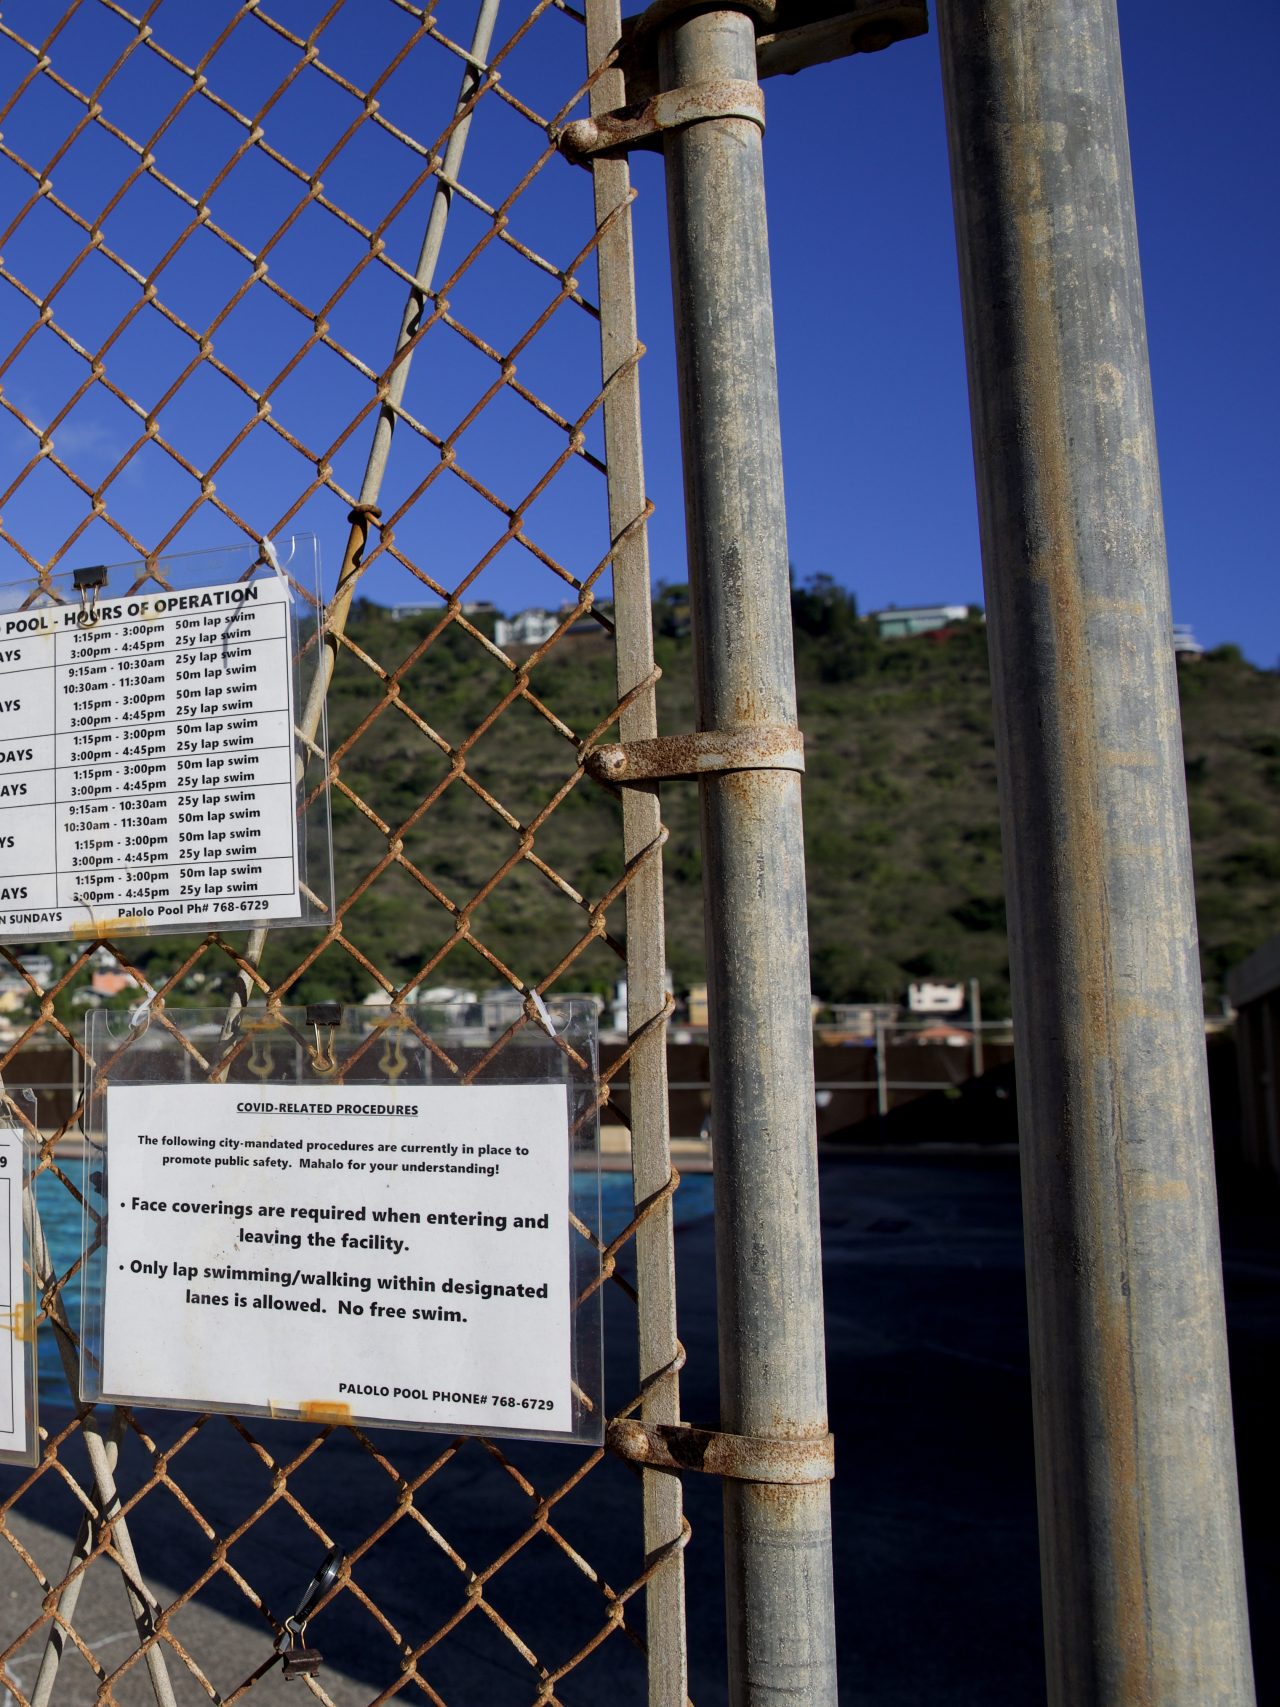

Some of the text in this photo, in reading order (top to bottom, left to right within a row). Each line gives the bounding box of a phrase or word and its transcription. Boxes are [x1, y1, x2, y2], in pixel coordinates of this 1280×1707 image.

[6, 617, 49, 635] POOL
[64, 605, 123, 624] HOURS
[127, 601, 149, 617] OF
[154, 587, 258, 613] OPERATION
[73, 629, 112, 643] 1:15pm
[123, 625, 165, 637] 3:00pm
[175, 619, 200, 630] 50m
[203, 616, 222, 628] lap
[225, 609, 256, 624] swim
[70, 647, 111, 659] 3:00pm
[122, 640, 165, 652] 4:45pm
[175, 635, 196, 647] 25y
[199, 633, 217, 644] lap
[220, 626, 251, 641] swim
[63, 682, 108, 694] 10:30am
[119, 675, 165, 687] 11:30am
[176, 670, 201, 681] 50m
[204, 668, 223, 680] lap
[223, 663, 257, 676] swim
[71, 750, 112, 762] 3:00pm
[122, 745, 166, 757] 4:45pm
[177, 740, 198, 753] 25y
[201, 739, 220, 751] lap
[223, 735, 254, 747] swim
[69, 804, 108, 816] 9:15am
[119, 799, 167, 811] 10:30am
[178, 795, 199, 808] 25y
[202, 794, 221, 806] lap
[224, 791, 256, 803] swim
[75, 875, 115, 887] 1:15pm
[126, 871, 169, 883] 3:00pm
[180, 868, 206, 879] 50m
[209, 866, 228, 879] lap
[231, 864, 262, 876] swim
[9, 912, 63, 925] SUNDAYS
[118, 900, 269, 918] Palolo Pool Ph# 768-6729
[237, 1102, 419, 1115] COVID-RELATED PROCEDURES
[137, 1135, 529, 1158] The following city-mandated procedures are currently in place to
[162, 1155, 499, 1177] promote public safety. Mahalo for your understanding!
[132, 1197, 549, 1232] Face coverings are required when entering and
[238, 1228, 410, 1255] leaving the facility.
[130, 1259, 548, 1300] Only lap swimming/walking within designated
[186, 1289, 468, 1323] lanes is allowed. No free swim.
[339, 1383, 554, 1411] PALOLO POOL PHONE# 768-6729
